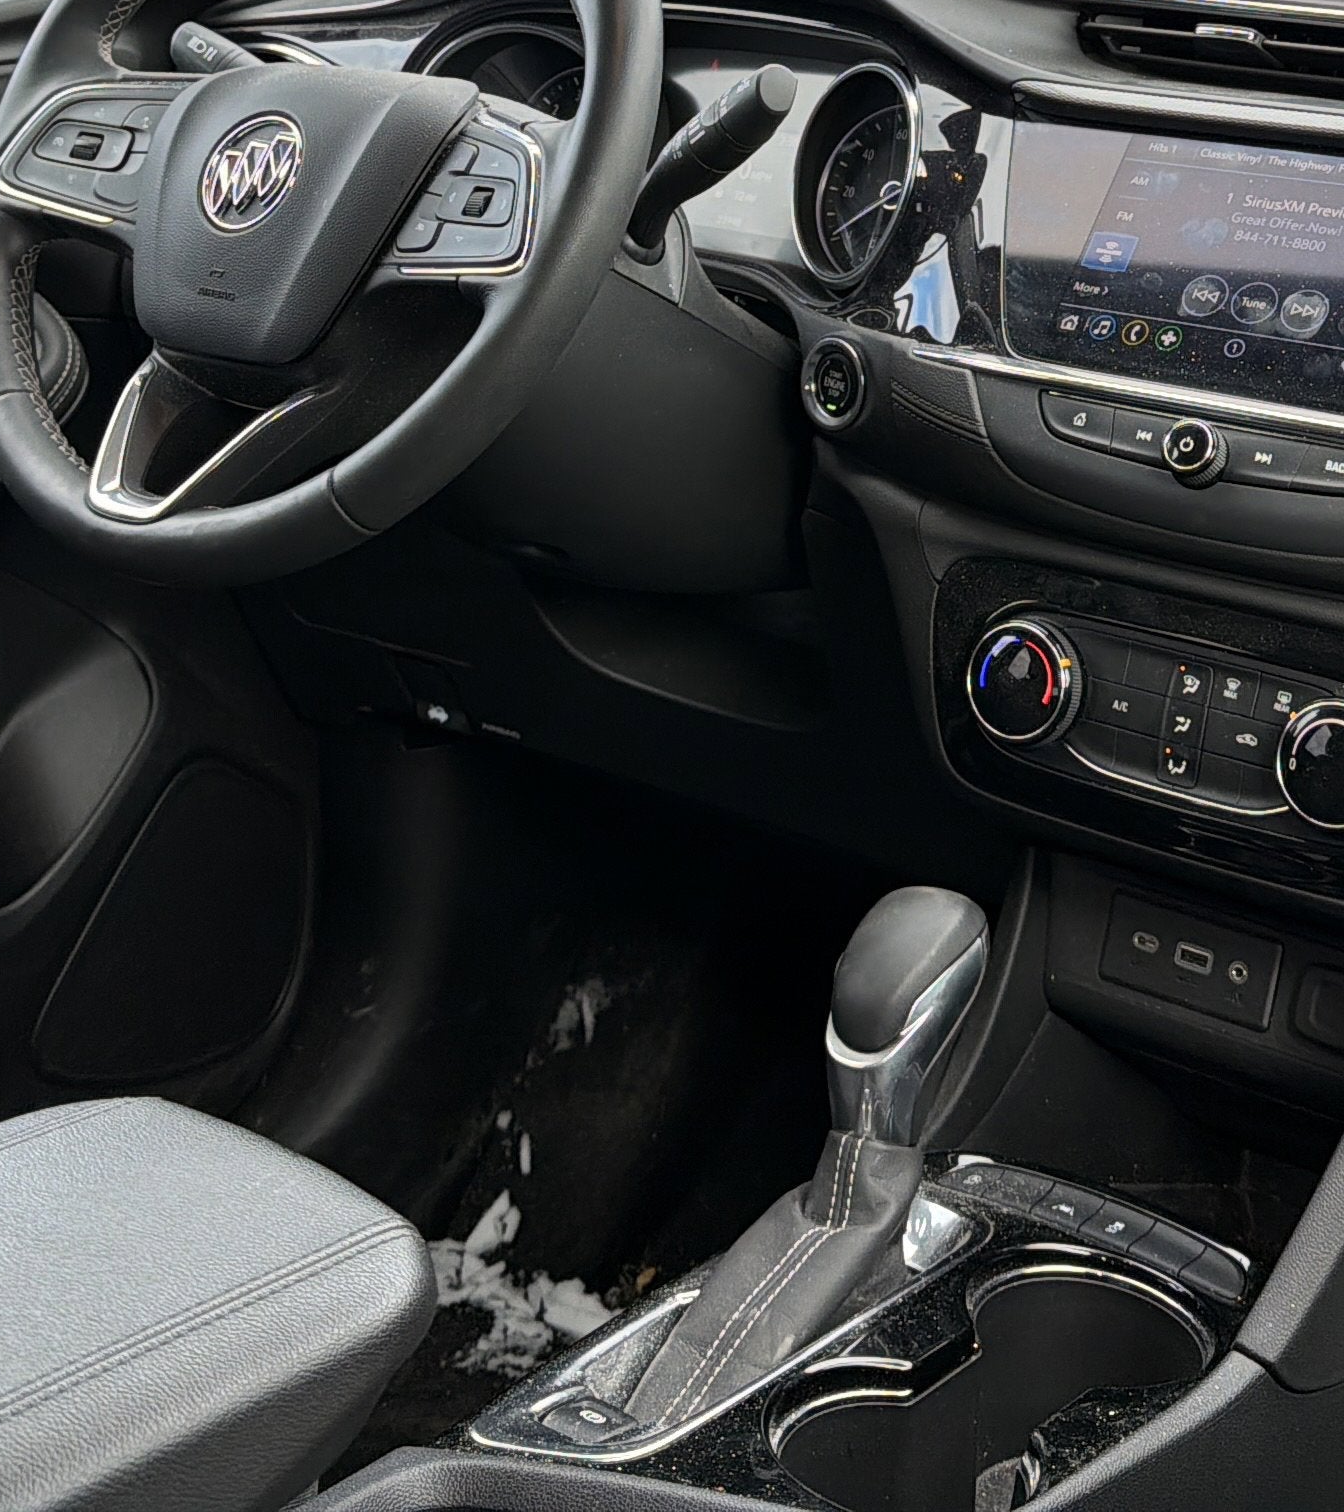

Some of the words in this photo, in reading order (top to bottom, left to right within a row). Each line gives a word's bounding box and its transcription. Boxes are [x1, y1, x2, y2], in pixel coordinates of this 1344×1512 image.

[895, 128, 908, 139] 60
[862, 147, 875, 162] 40
[1148, 141, 1169, 154] Hits
[1170, 144, 1177, 155] 1
[1200, 147, 1236, 162] Classic
[1237, 151, 1263, 165] Vinyl
[1268, 155, 1287, 168] The
[1288, 157, 1337, 176] Highway
[1130, 174, 1150, 187] AM
[842, 184, 857, 199] 20
[1226, 191, 1234, 206] 1
[1242, 194, 1306, 214] SiriusXM
[1115, 210, 1135, 222] FM
[1231, 211, 1267, 228] Great
[1269, 215, 1306, 233] Offer
[1306, 221, 1344, 238] Now!
[1233, 229, 1328, 253] 844-711-8800
[1072, 280, 1102, 296] More
[1241, 295, 1268, 311] Tune
[823, 375, 846, 393] ENGINE
[1222, 688, 1239, 701] MAX
[1111, 697, 1129, 714] A/C
[1272, 699, 1291, 715] REAR
